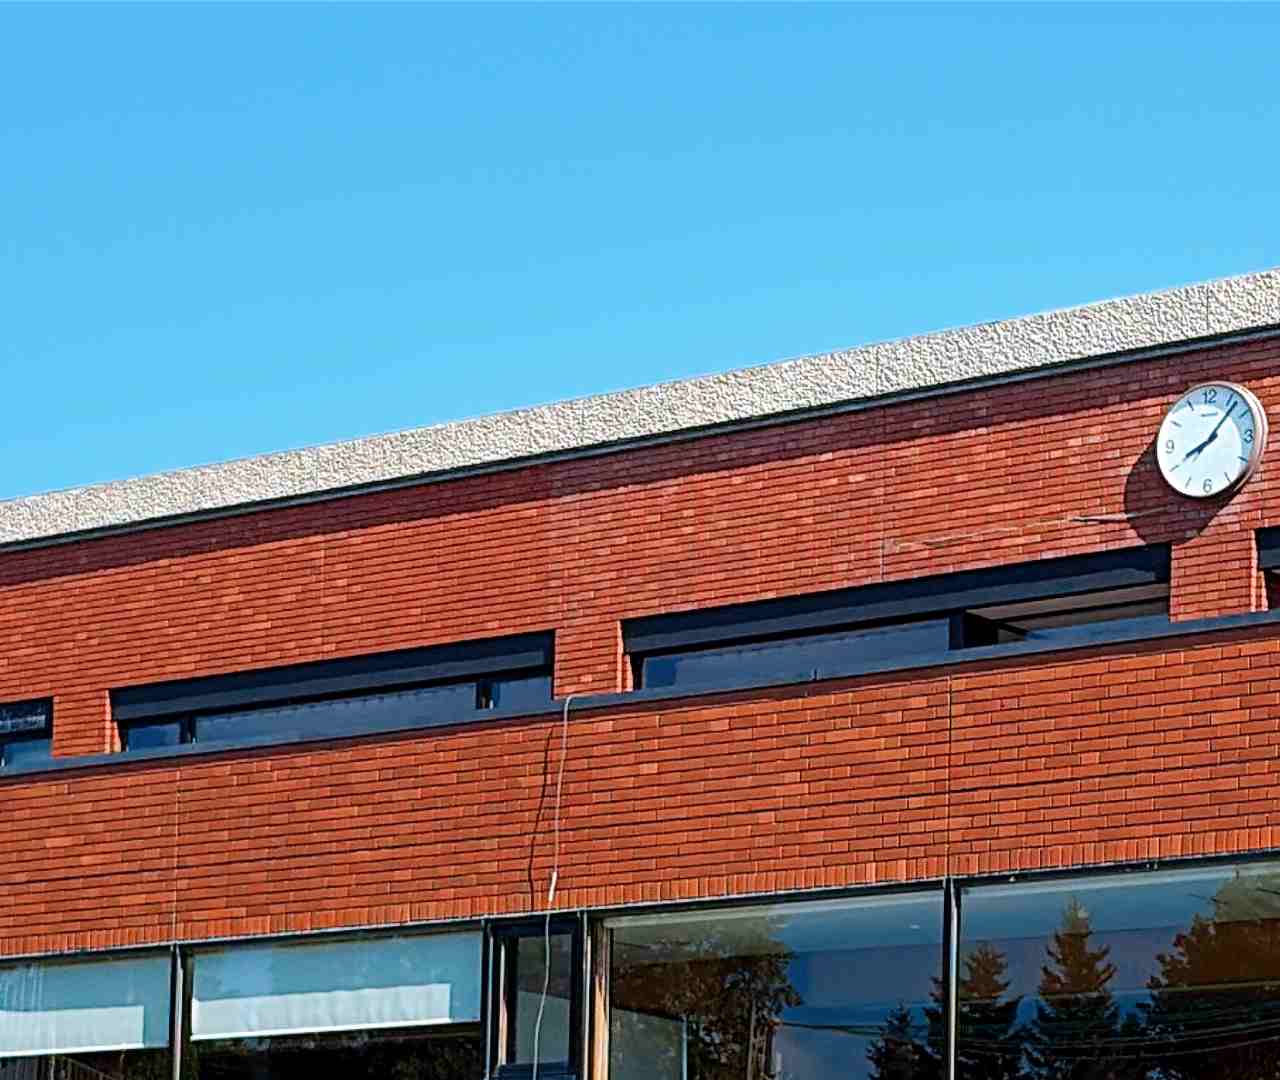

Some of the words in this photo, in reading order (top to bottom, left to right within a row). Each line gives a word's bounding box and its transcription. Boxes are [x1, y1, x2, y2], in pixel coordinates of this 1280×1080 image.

[1202, 390, 1218, 405] 12
[1244, 429, 1254, 443] 3
[1165, 440, 1175, 454] 9
[1203, 479, 1213, 493] 6
